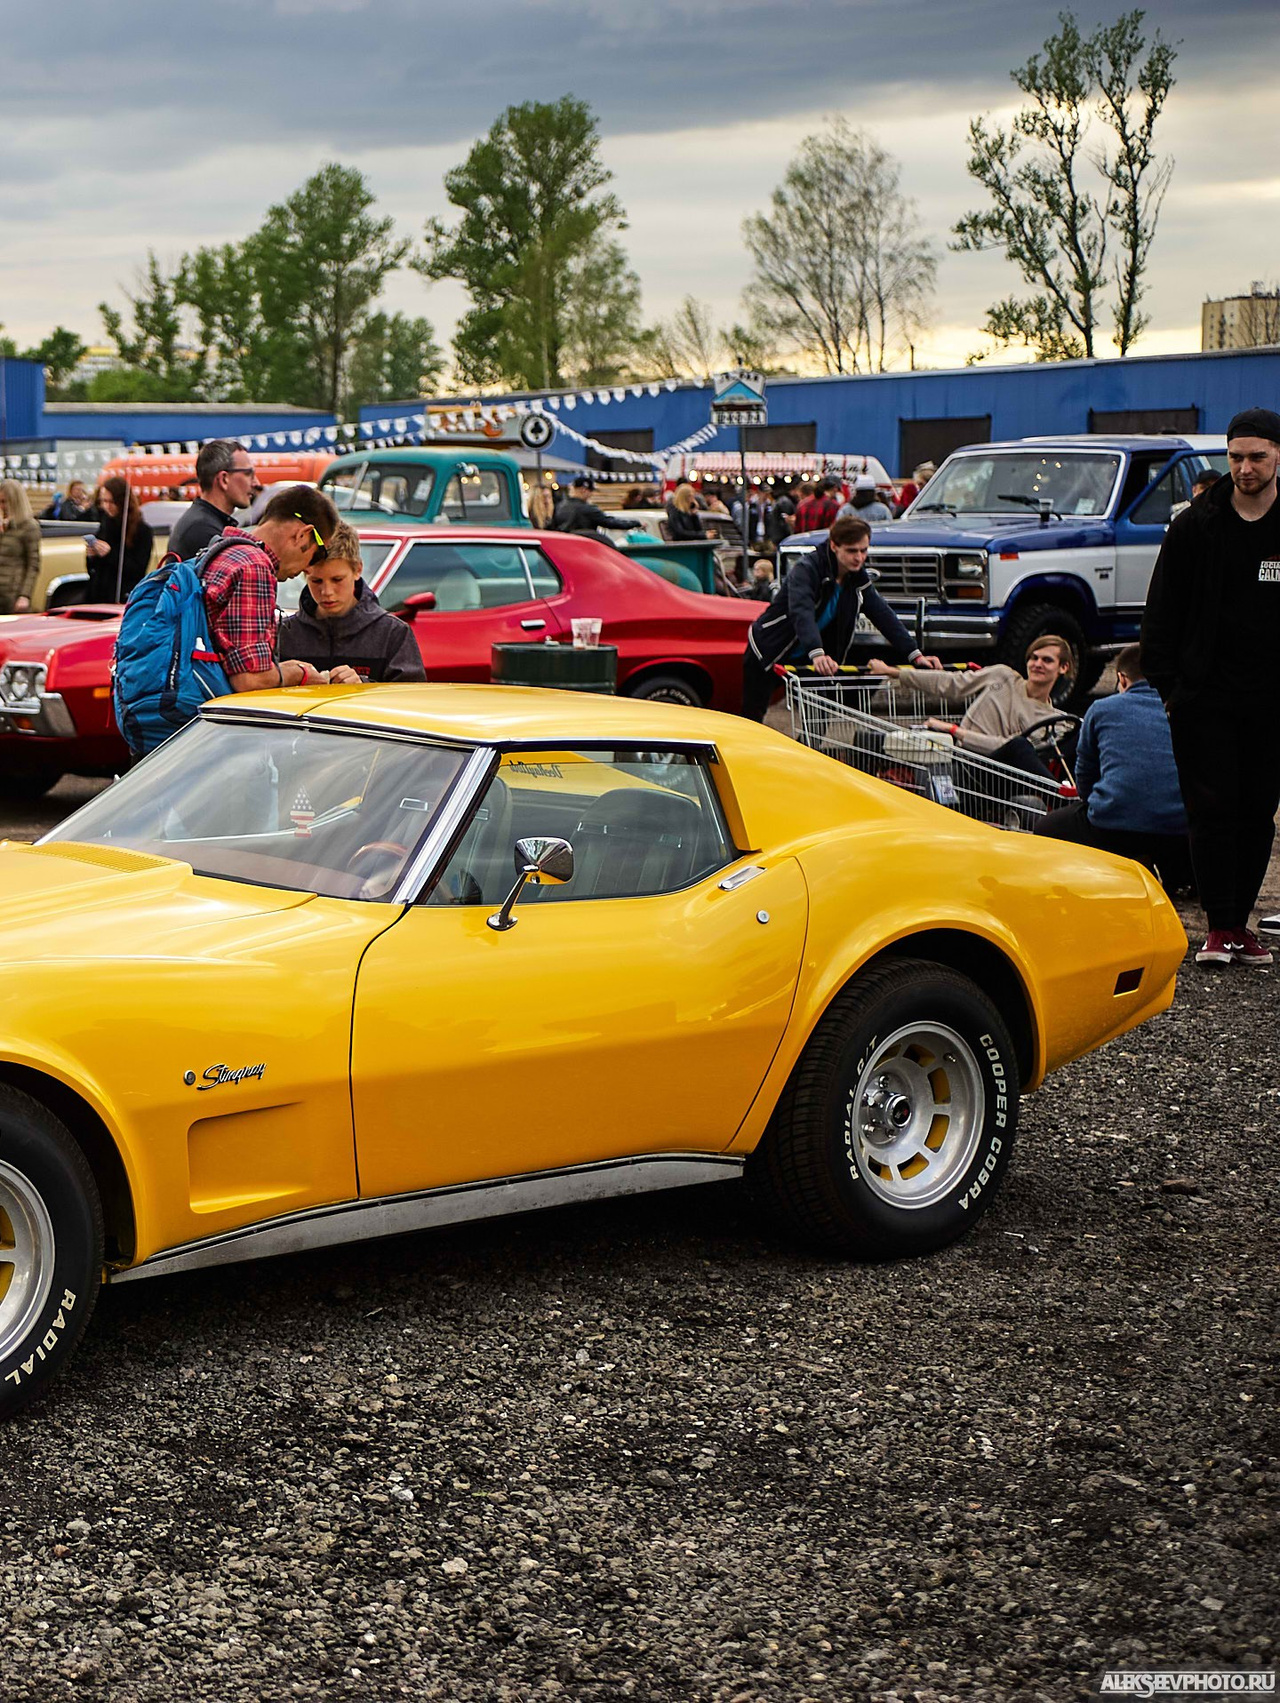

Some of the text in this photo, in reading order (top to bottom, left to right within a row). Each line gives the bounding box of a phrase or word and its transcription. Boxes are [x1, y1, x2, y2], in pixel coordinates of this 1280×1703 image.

[196, 1063, 267, 1091] Stingray
[958, 1034, 1008, 1210] COOPER COBRA
[4, 1288, 77, 1386] RADIAL
